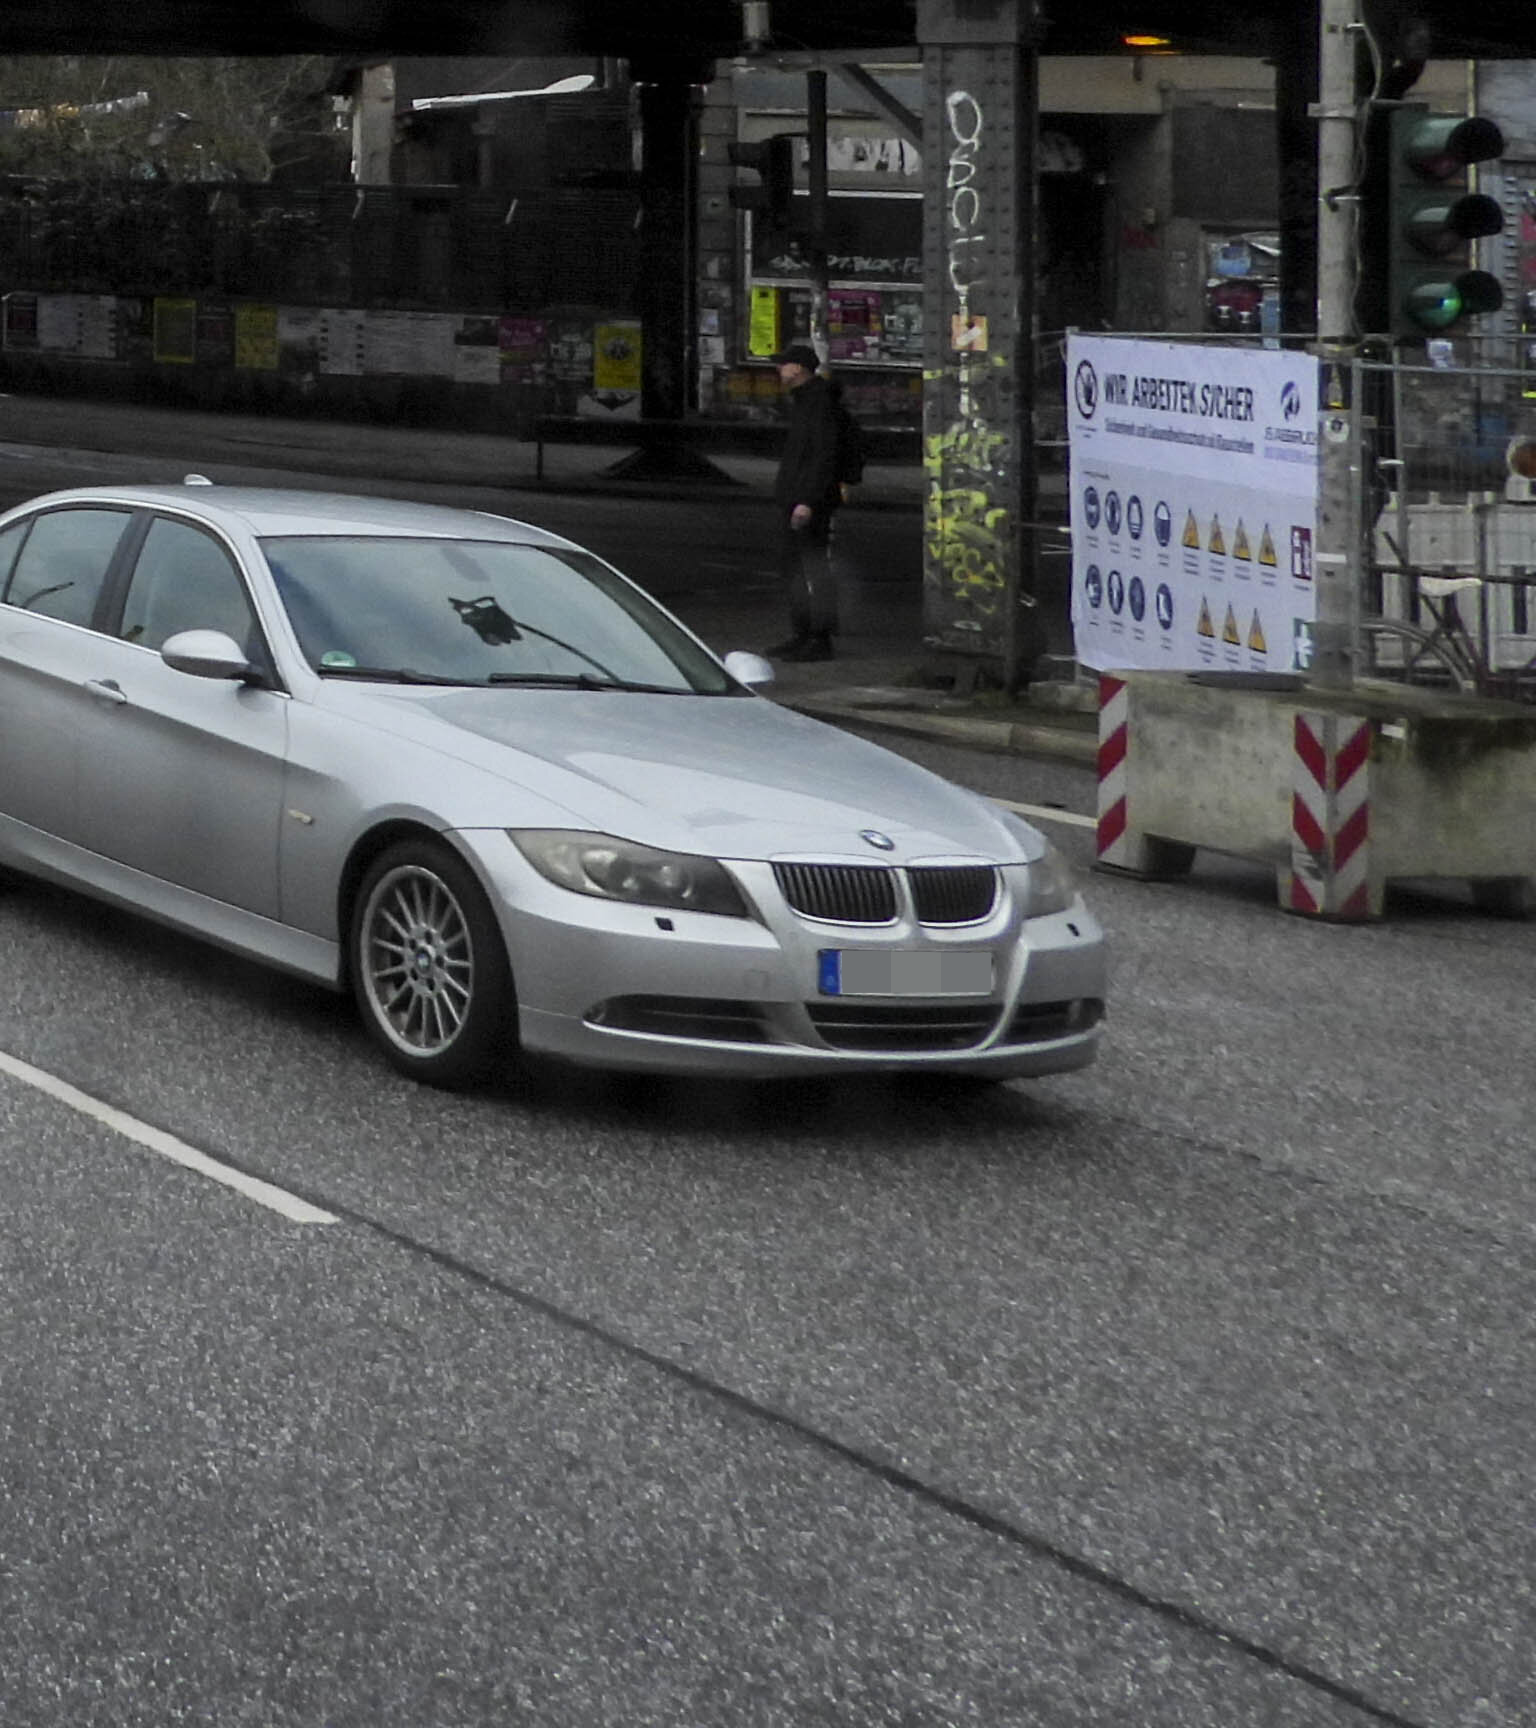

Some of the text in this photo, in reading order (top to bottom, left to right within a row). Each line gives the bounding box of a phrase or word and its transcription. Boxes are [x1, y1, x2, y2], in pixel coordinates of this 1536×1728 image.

[1104, 373, 1255, 422] WIR ARBEITEN SICHER
